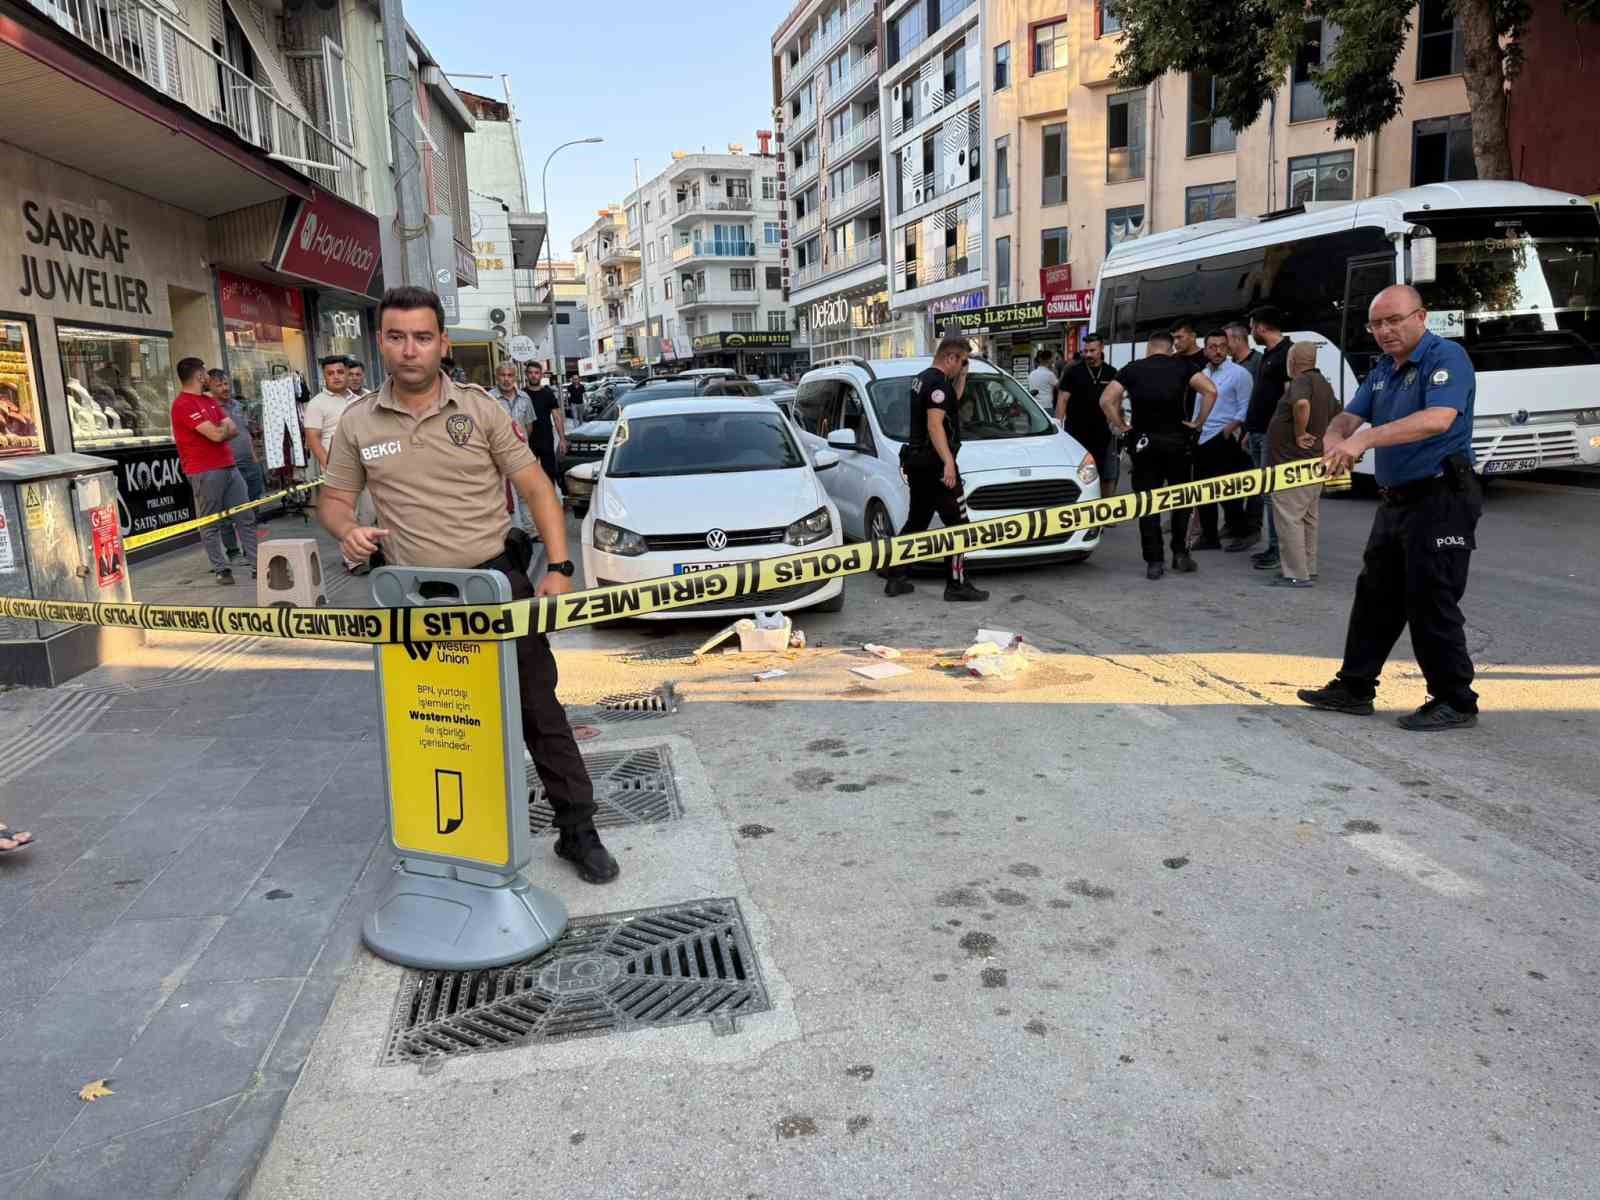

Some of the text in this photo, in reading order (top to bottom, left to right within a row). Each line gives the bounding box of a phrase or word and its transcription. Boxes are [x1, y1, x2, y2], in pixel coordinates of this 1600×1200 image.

[22, 200, 130, 264] SARRAF
[19, 254, 152, 314] JUWELIER
[985, 303, 1043, 324] İLETİŞİM
[1047, 300, 1083, 314] OSMANLI
[125, 458, 183, 492] KOÇAK
[1284, 462, 1326, 485] OLİS
[437, 641, 480, 654] Western
[437, 651, 469, 664] Union
[409, 710, 481, 726] Western Union
